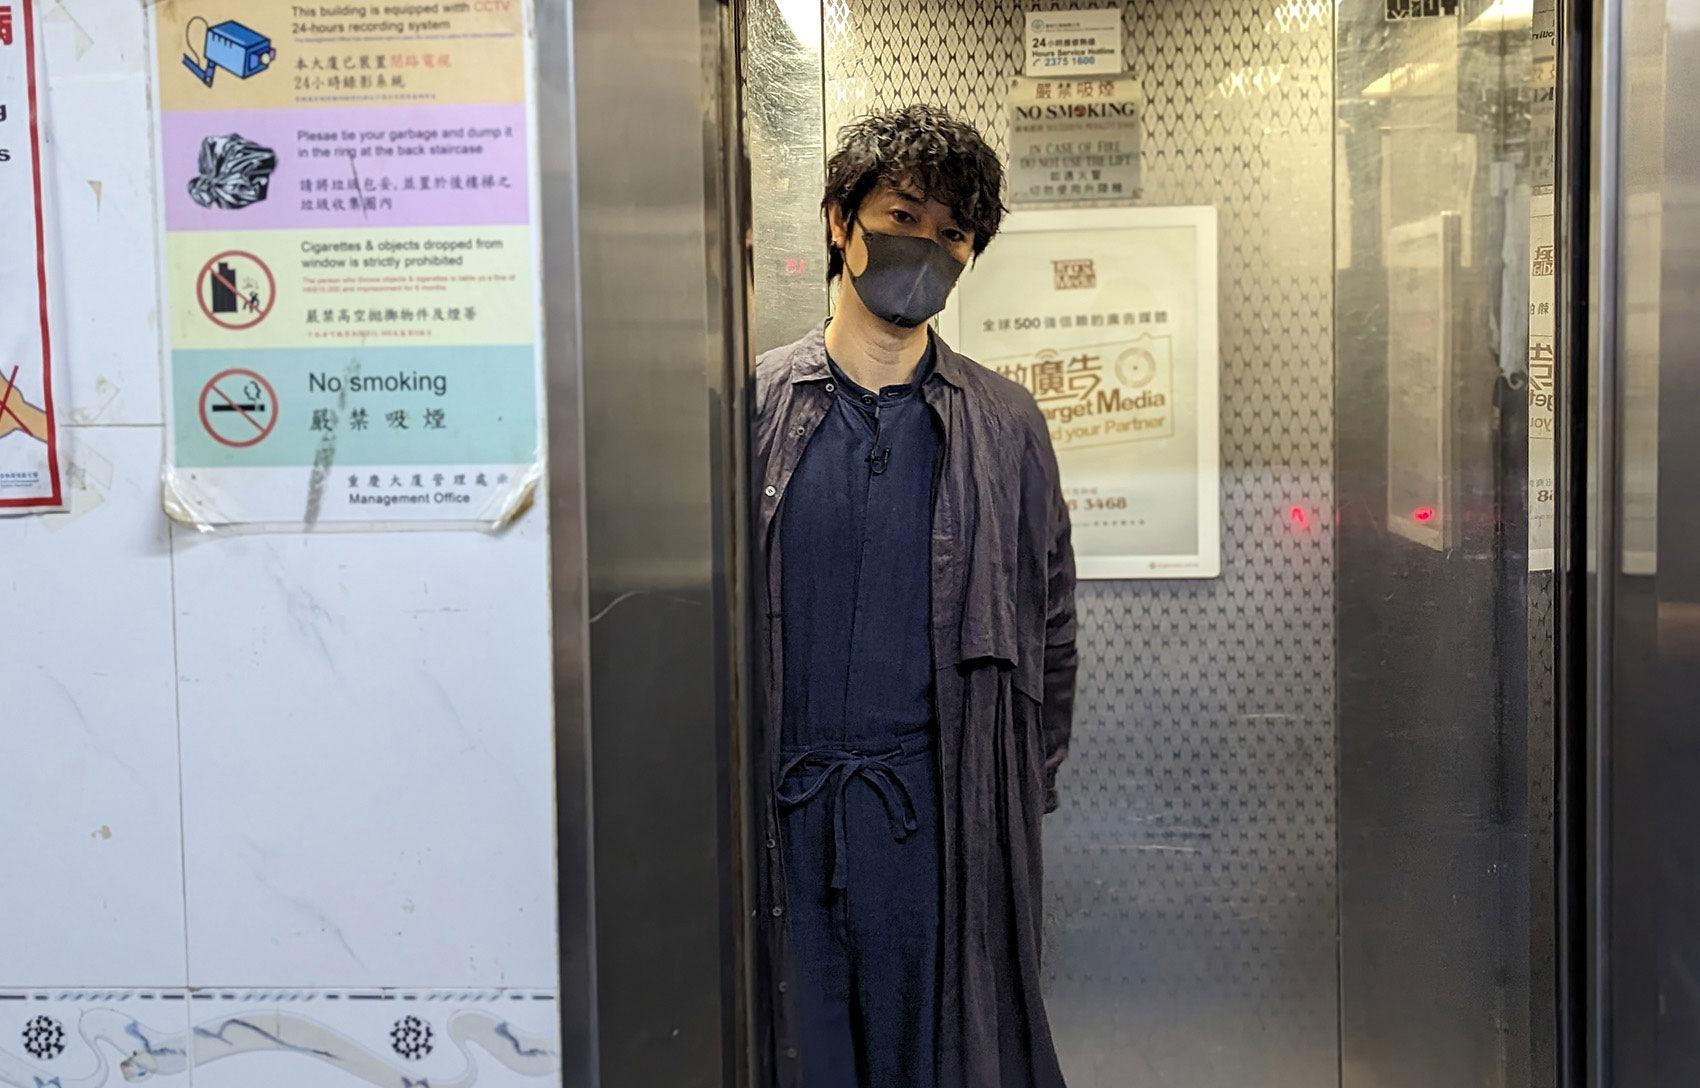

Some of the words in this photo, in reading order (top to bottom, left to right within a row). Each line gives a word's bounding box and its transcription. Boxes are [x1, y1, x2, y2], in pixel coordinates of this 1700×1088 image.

[292, 5, 317, 18] This
[320, 3, 367, 18] building
[370, 4, 380, 15] is
[384, 2, 439, 16] equipped
[474, 0, 511, 12] CCTV
[292, 21, 345, 34] 24-hours
[348, 19, 404, 33] recording
[408, 18, 451, 32] system
[1032, 38, 1047, 49] 24
[1016, 105, 1042, 120] NO
[1045, 101, 1136, 120] SMOKING
[341, 130, 356, 141] tie
[360, 131, 386, 142] your
[388, 128, 438, 142] garbage
[441, 127, 464, 138] and
[467, 127, 502, 139] dump
[505, 126, 513, 137] it
[297, 147, 309, 158] in
[312, 146, 331, 157] the
[360, 146, 372, 157] at
[374, 145, 394, 156] the
[398, 144, 426, 156] back
[429, 143, 483, 155] staircase
[301, 240, 361, 254] Cigarettes
[365, 239, 374, 250] &
[377, 238, 420, 252] objects
[423, 238, 473, 252] dropped
[476, 238, 504, 249] from
[301, 257, 346, 269] window
[349, 256, 359, 267] is
[363, 255, 401, 269] strictly
[404, 254, 463, 269] prohibited
[309, 373, 342, 393] No
[350, 371, 448, 396] smoking
[1045, 401, 1093, 424] arget
[1097, 388, 1166, 415] Media
[310, 407, 447, 432] 嚴禁吸煙
[1065, 424, 1102, 443] your
[1105, 416, 1166, 434] Partner
[348, 493, 430, 506] Management
[434, 491, 470, 504] Office
